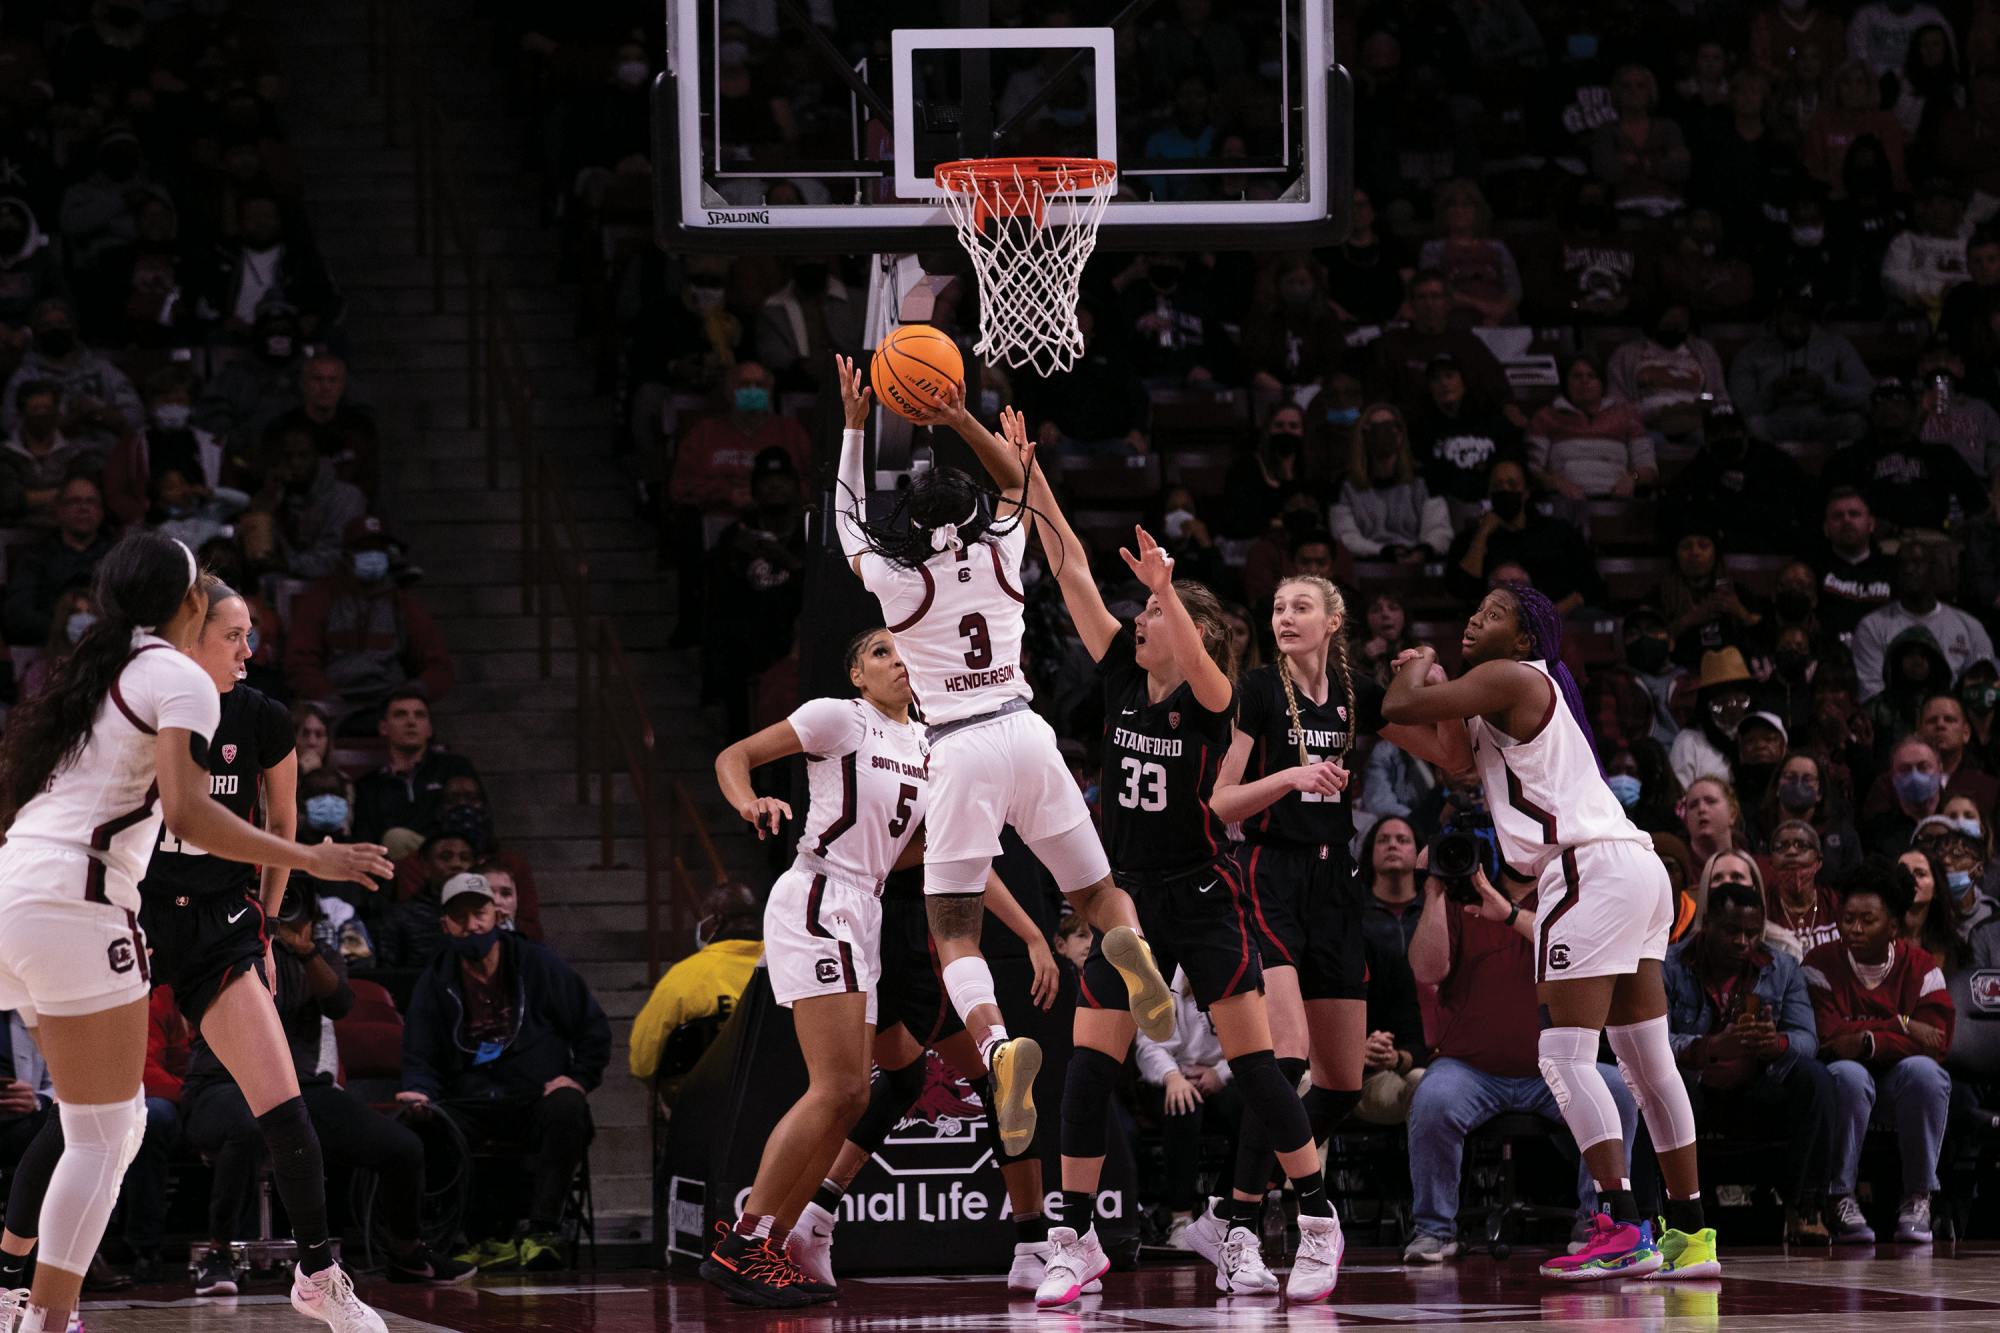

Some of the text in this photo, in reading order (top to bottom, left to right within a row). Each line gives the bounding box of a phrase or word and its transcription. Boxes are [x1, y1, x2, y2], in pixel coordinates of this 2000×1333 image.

[707, 210, 769, 225] SPALDING
[958, 612, 993, 670] 3
[944, 664, 1015, 692] HENDERSON
[1113, 726, 1183, 757] STANFORD
[871, 755, 900, 774] SOUTH
[1118, 756, 1168, 812] 33
[888, 782, 918, 838] 5
[918, 1181, 989, 1222] Life
